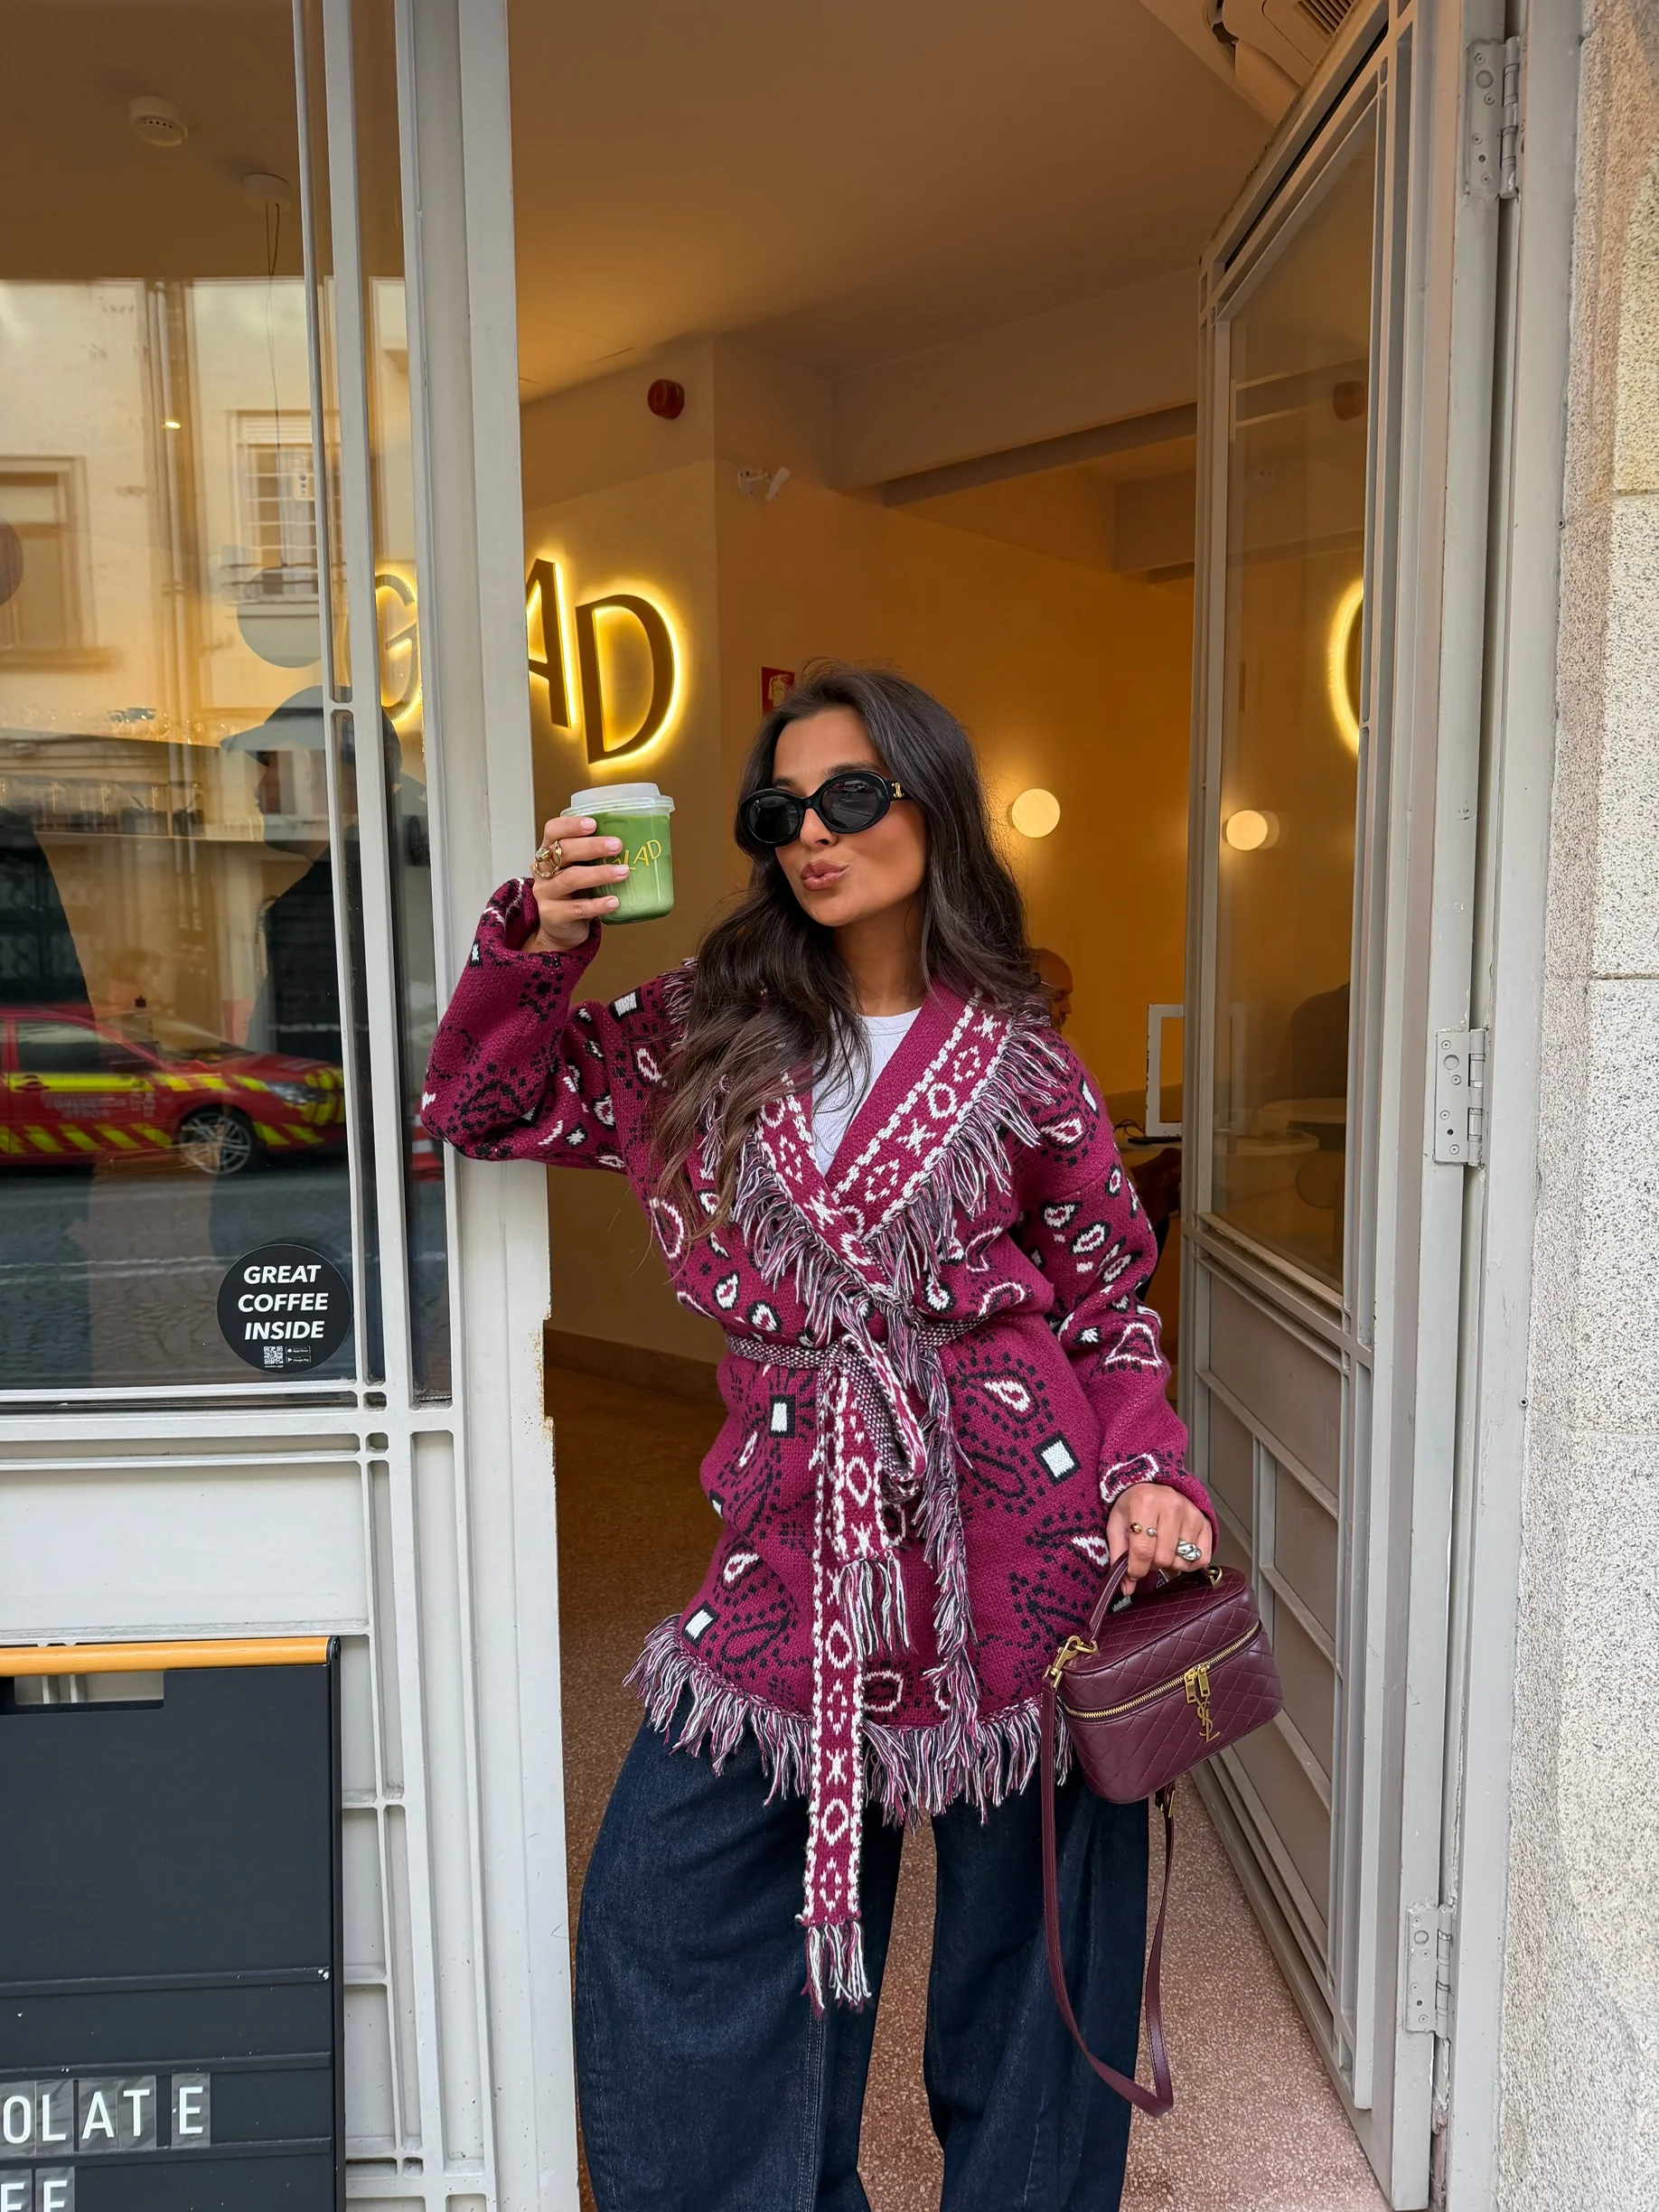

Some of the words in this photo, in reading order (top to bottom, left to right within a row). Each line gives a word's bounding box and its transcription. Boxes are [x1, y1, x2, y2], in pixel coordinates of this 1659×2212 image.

[376, 558, 674, 764] GAD
[604, 839, 662, 871] LAD
[244, 1265, 322, 1284] GREAT
[238, 1293, 329, 1313] COFFEE
[244, 1321, 325, 1340] INSIDE
